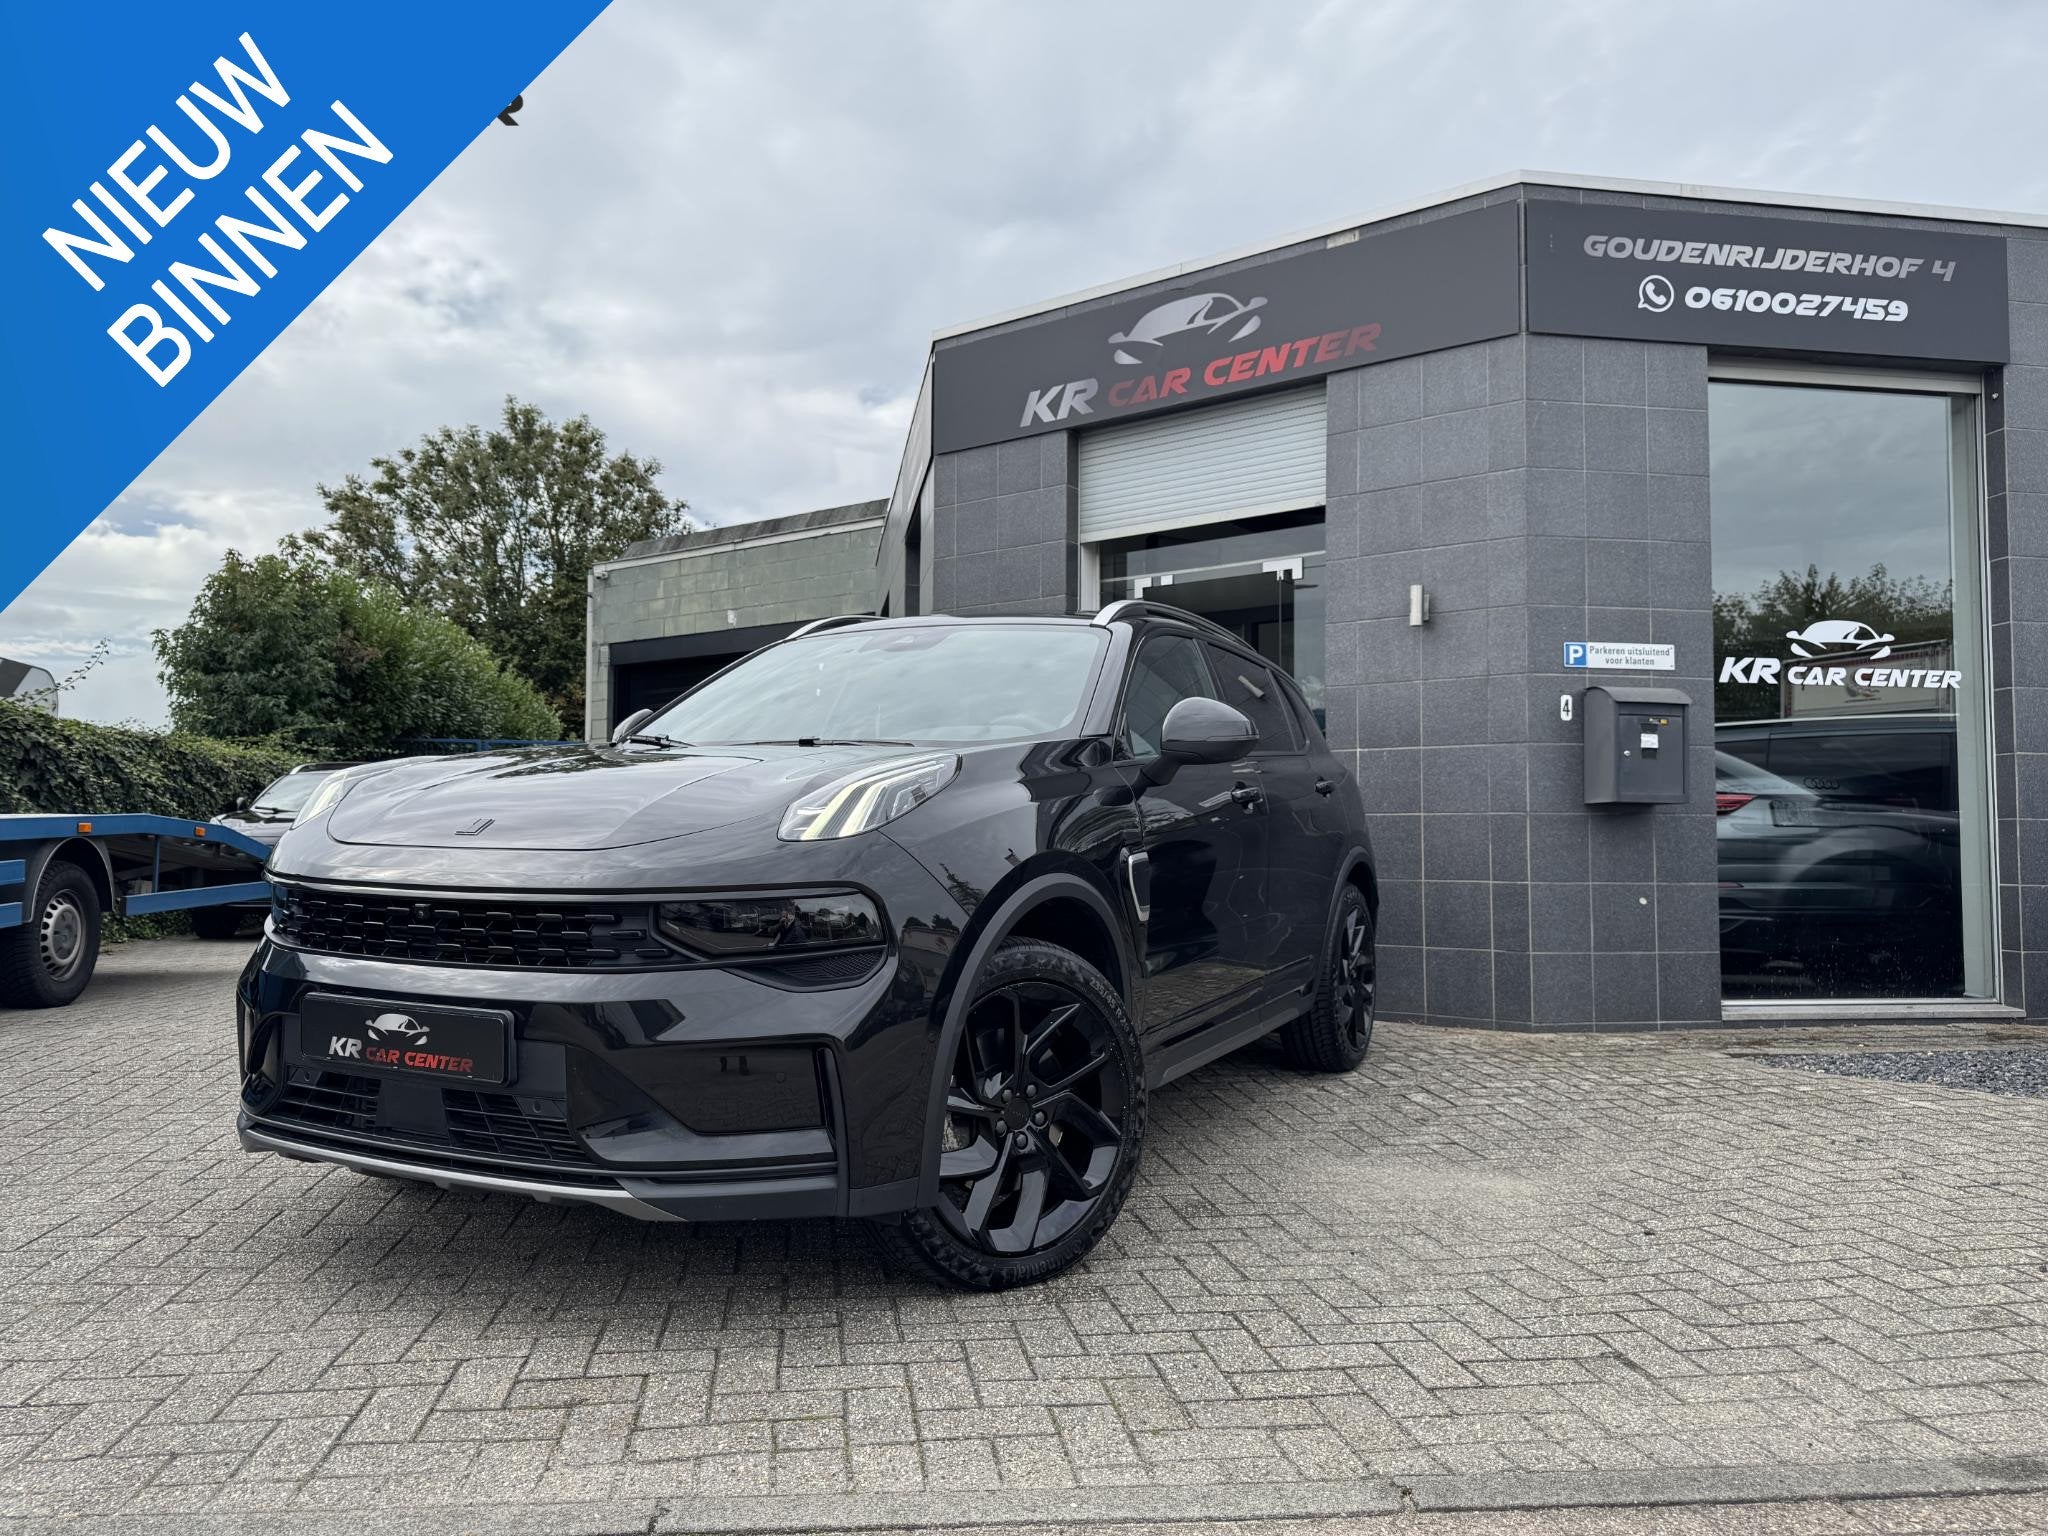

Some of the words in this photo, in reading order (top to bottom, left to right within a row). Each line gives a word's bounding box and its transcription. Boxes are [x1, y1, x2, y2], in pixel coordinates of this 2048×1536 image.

[1583, 234, 1924, 279] GOUDENRIJDERHOF
[1931, 261, 1956, 282] 4
[1684, 286, 1909, 322] 0610027459
[1019, 378, 1098, 428] KR
[1107, 367, 1191, 408] CAR
[1204, 322, 1382, 387] CENTER
[1569, 645, 1583, 664] P
[1589, 645, 1626, 656] Parkeren
[1627, 647, 1671, 657] uitsluitend
[1605, 657, 1623, 665] voor
[1625, 657, 1655, 666] klanten
[1718, 656, 1781, 684] KR
[1787, 666, 1846, 686] CAR
[1854, 668, 1962, 689] CENTER
[1562, 699, 1571, 716] 4
[328, 1036, 362, 1059] KR
[365, 1047, 400, 1064] CAR
[404, 1051, 474, 1072] CENTER
